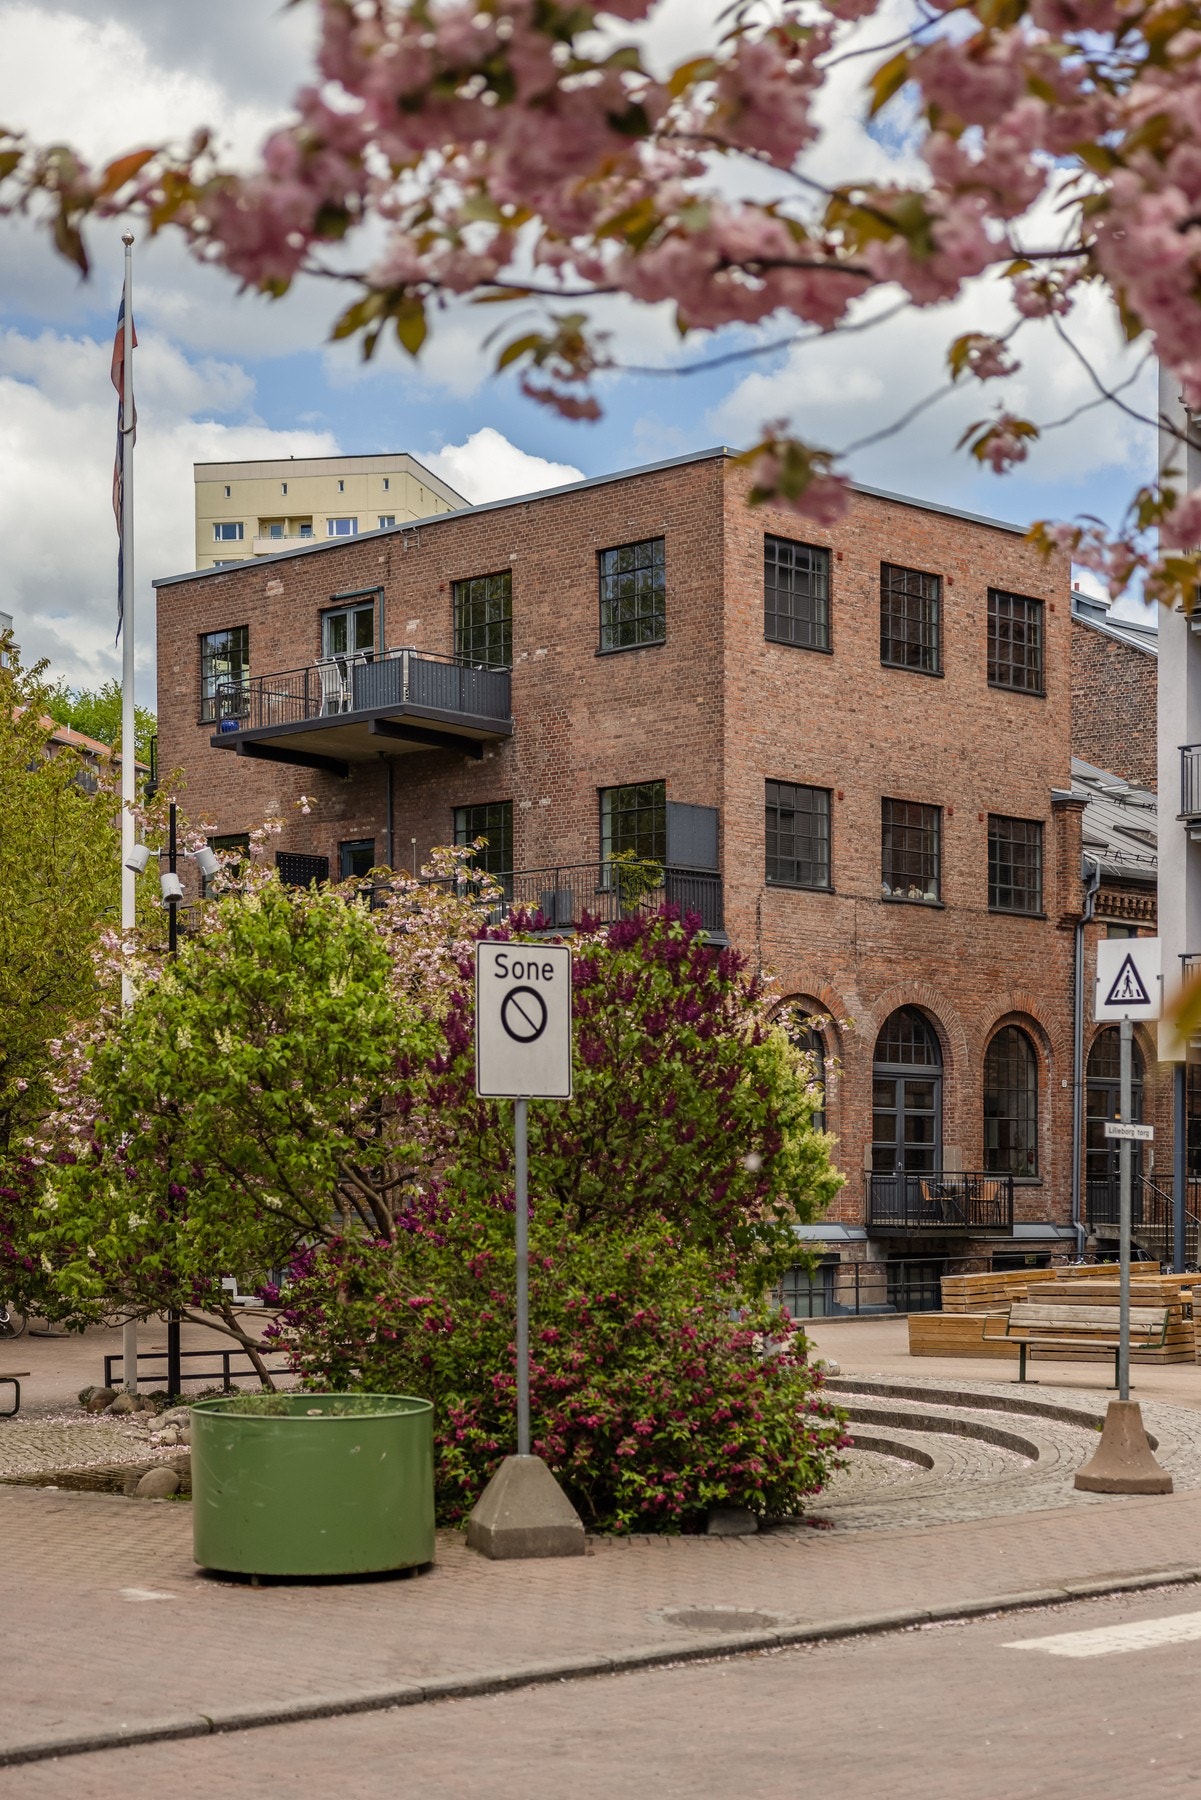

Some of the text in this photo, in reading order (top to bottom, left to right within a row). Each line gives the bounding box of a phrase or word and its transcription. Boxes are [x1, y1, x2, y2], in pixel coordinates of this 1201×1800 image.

[494, 953, 554, 981] Sone
[1108, 1126, 1150, 1138] Lilleborg torg
